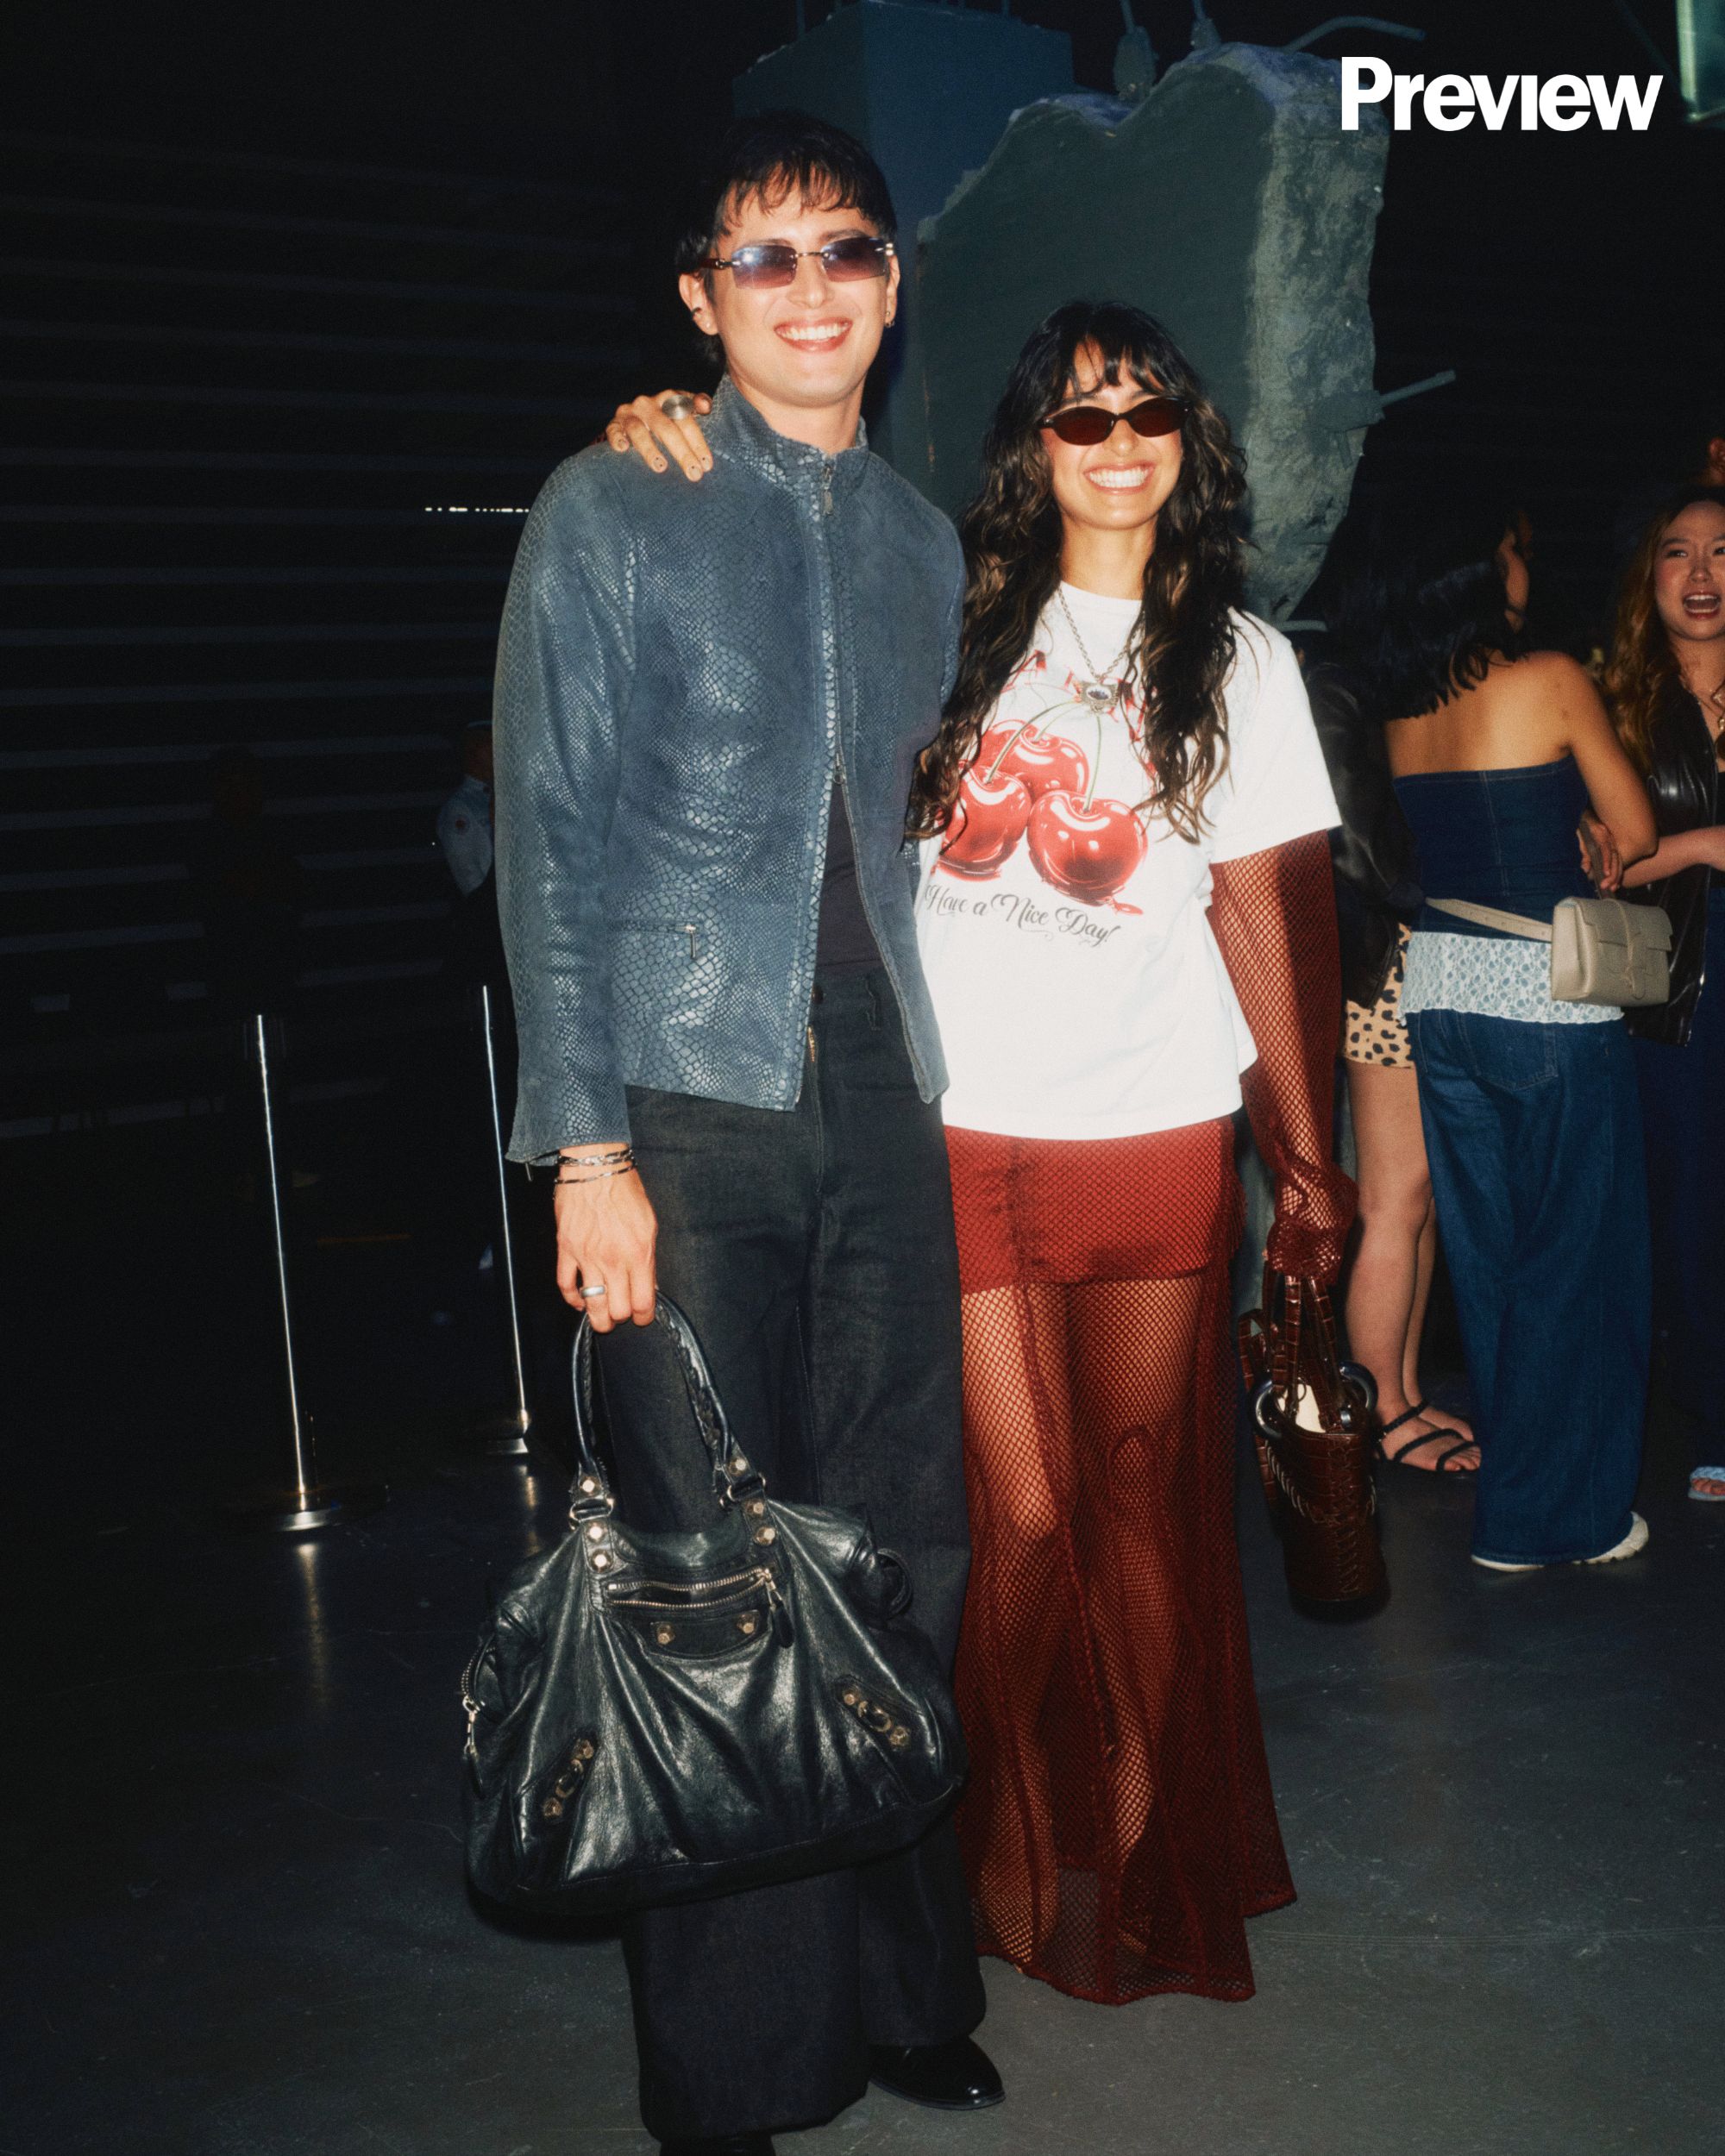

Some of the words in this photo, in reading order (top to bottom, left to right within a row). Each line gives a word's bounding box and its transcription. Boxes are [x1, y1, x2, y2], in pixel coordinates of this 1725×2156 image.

[925, 885, 969, 916] Have
[973, 900, 989, 917] a
[990, 893, 1054, 942] Nice
[1055, 907, 1121, 948] Day!
